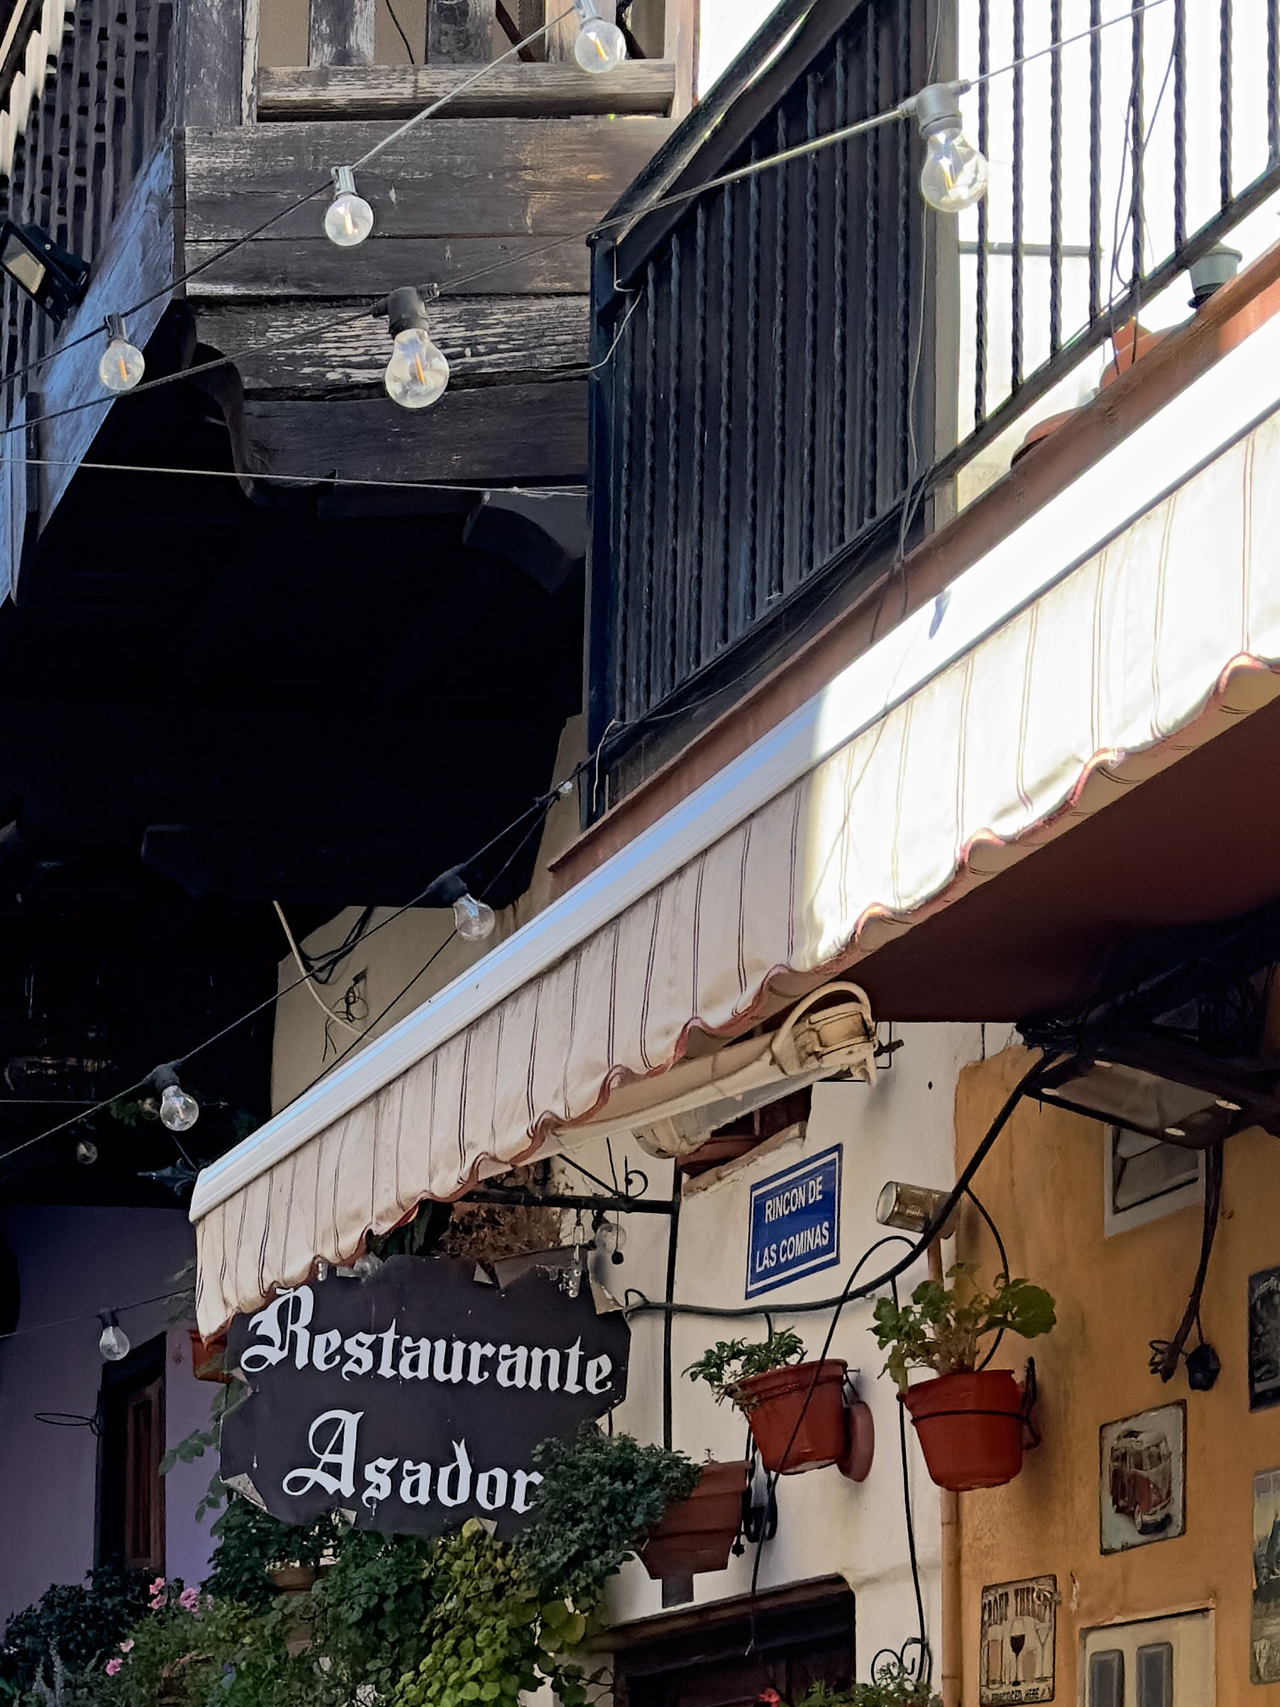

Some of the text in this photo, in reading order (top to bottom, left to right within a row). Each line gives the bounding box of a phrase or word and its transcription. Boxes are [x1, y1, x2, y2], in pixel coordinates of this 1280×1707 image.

[764, 1175, 824, 1224] RINCON DE
[755, 1221, 830, 1274] LAS COMINAS
[240, 1286, 613, 1397] Restaurante
[281, 1408, 544, 1515] Asador
